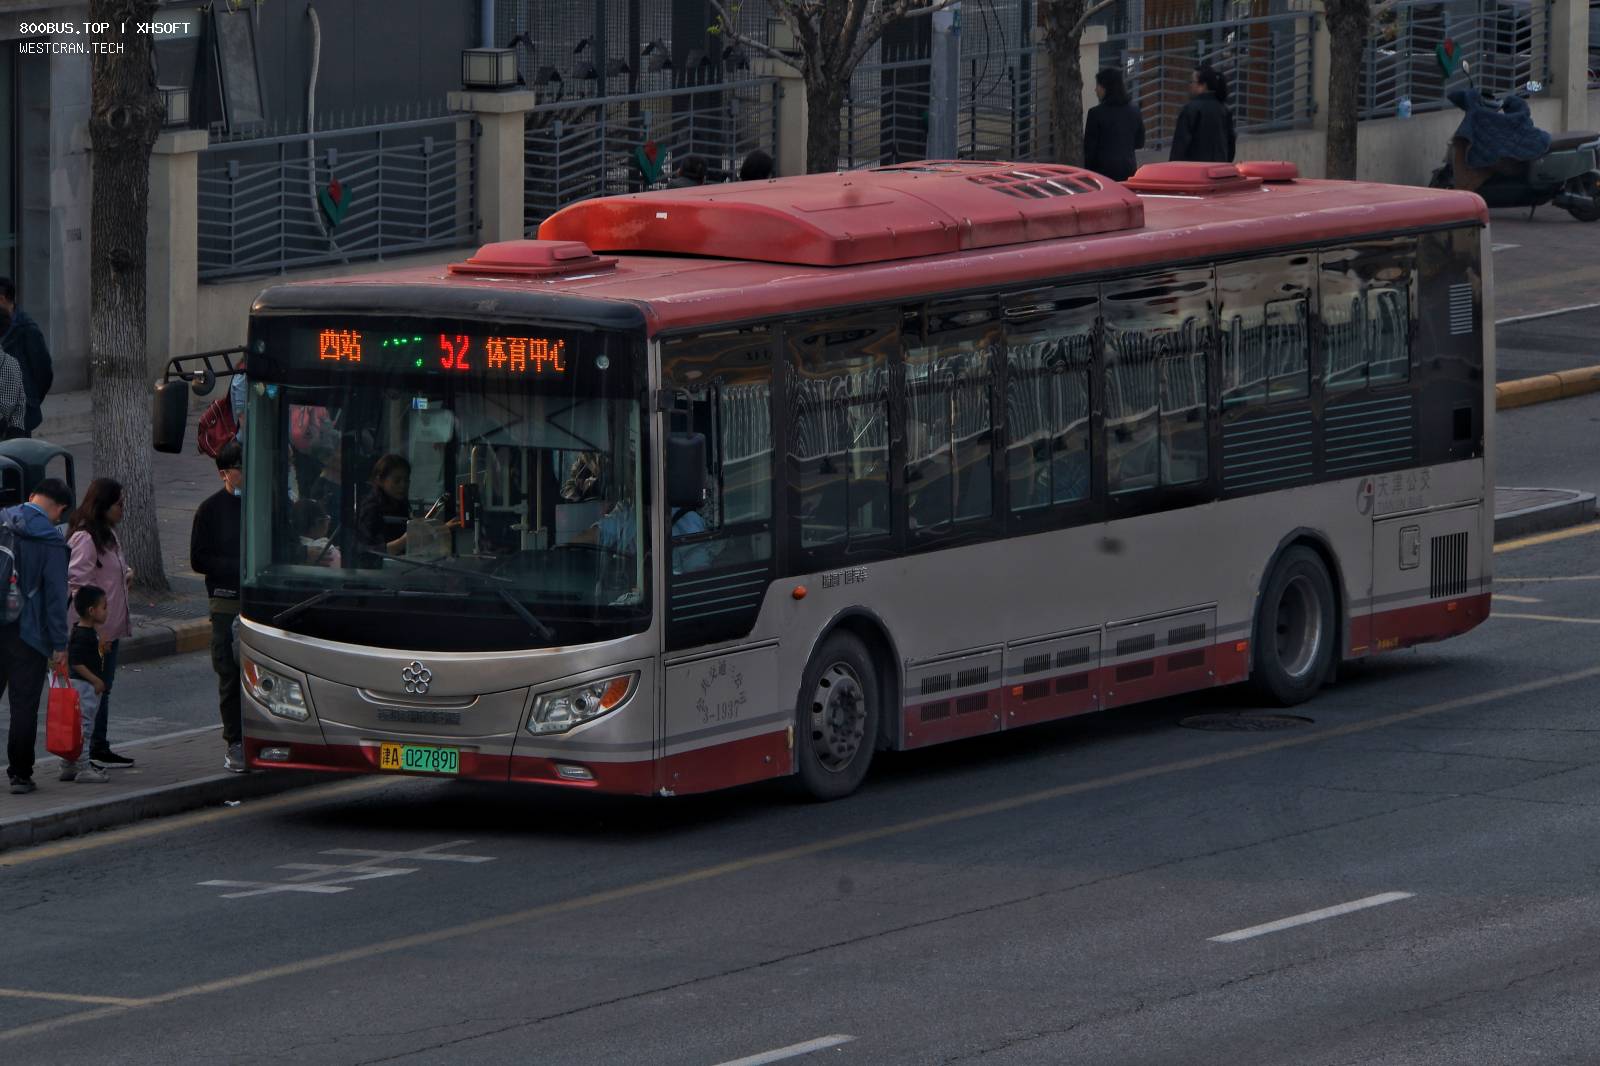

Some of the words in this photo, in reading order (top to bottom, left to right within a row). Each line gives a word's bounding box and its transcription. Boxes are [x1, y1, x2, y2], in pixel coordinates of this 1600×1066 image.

[319, 329, 362, 362] 西站
[440, 334, 470, 370] 52
[485, 336, 565, 373] 体育中心
